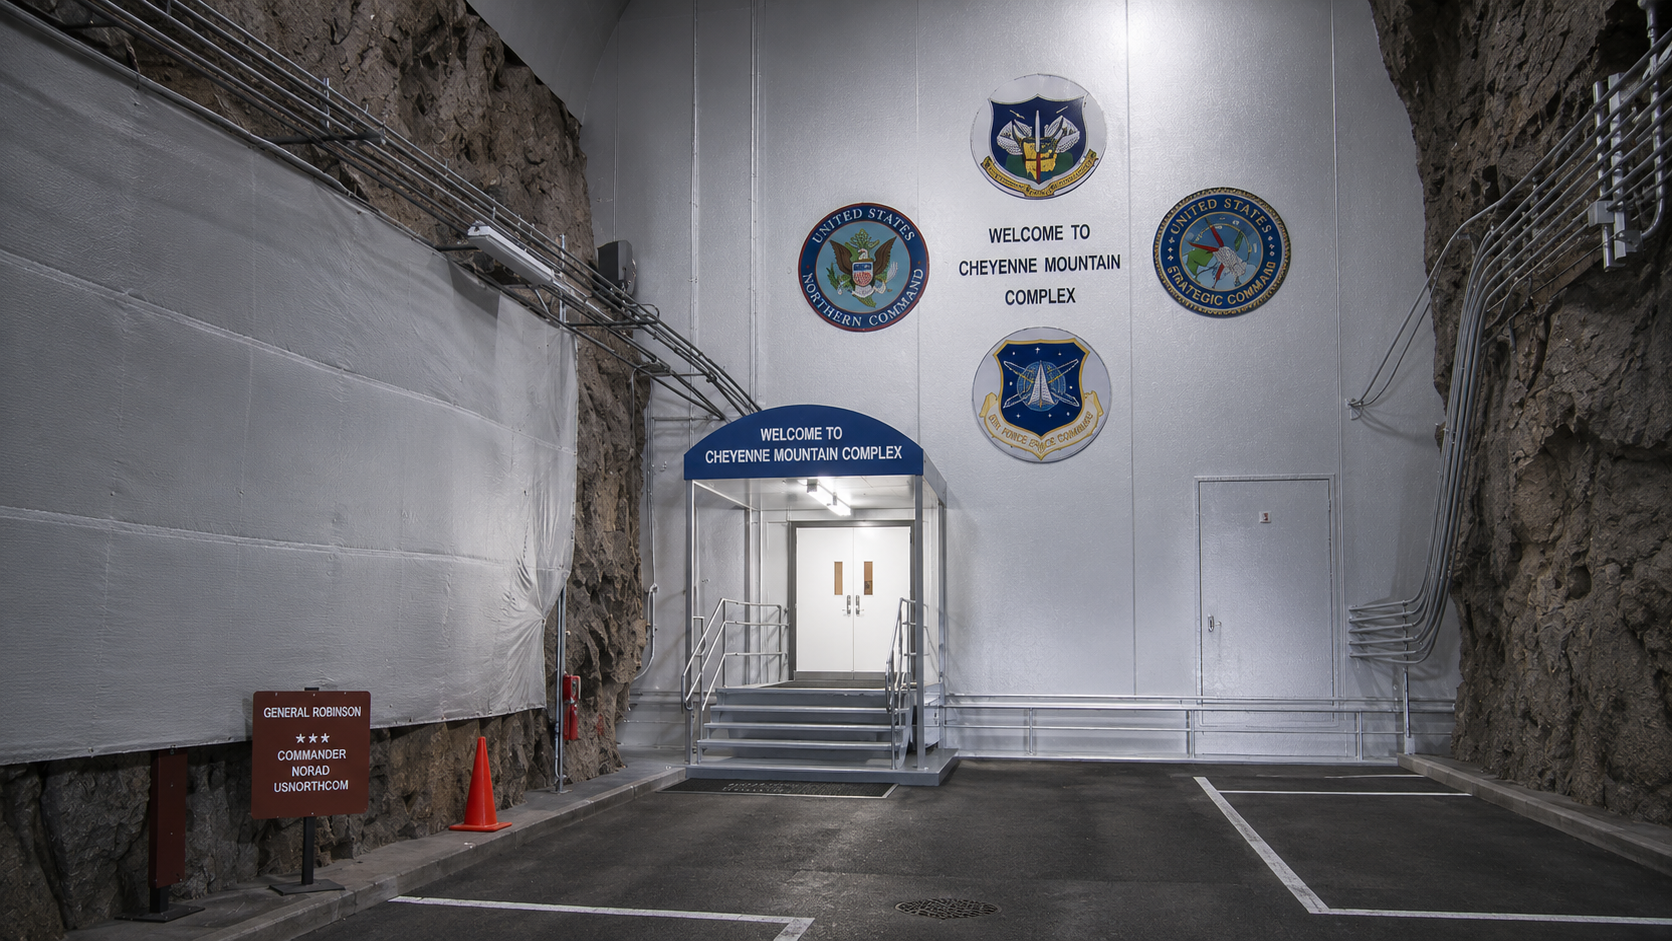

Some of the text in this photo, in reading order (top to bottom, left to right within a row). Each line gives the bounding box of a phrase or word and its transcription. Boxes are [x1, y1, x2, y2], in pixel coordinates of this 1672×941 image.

[812, 208, 916, 244] UNITED STATES
[1170, 198, 1272, 235] UNITED STATES
[988, 223, 1091, 244] WELCOME TO
[958, 254, 1121, 276] CHEYENNE MOUNTAIN
[1227, 261, 1276, 305] COMMAND
[802, 268, 924, 327] NORTHERN COMMAND
[1005, 287, 1076, 306] COMPLEX
[760, 426, 843, 442] WELCOME TO
[705, 445, 902, 464] CHEYENNE MOUNTAIN COMPLEX
[263, 706, 362, 718] GENERAL ROBINSON
[277, 748, 347, 761] COMMANDER
[291, 764, 331, 777] NORAD
[273, 780, 349, 793] USNORTHCOM
